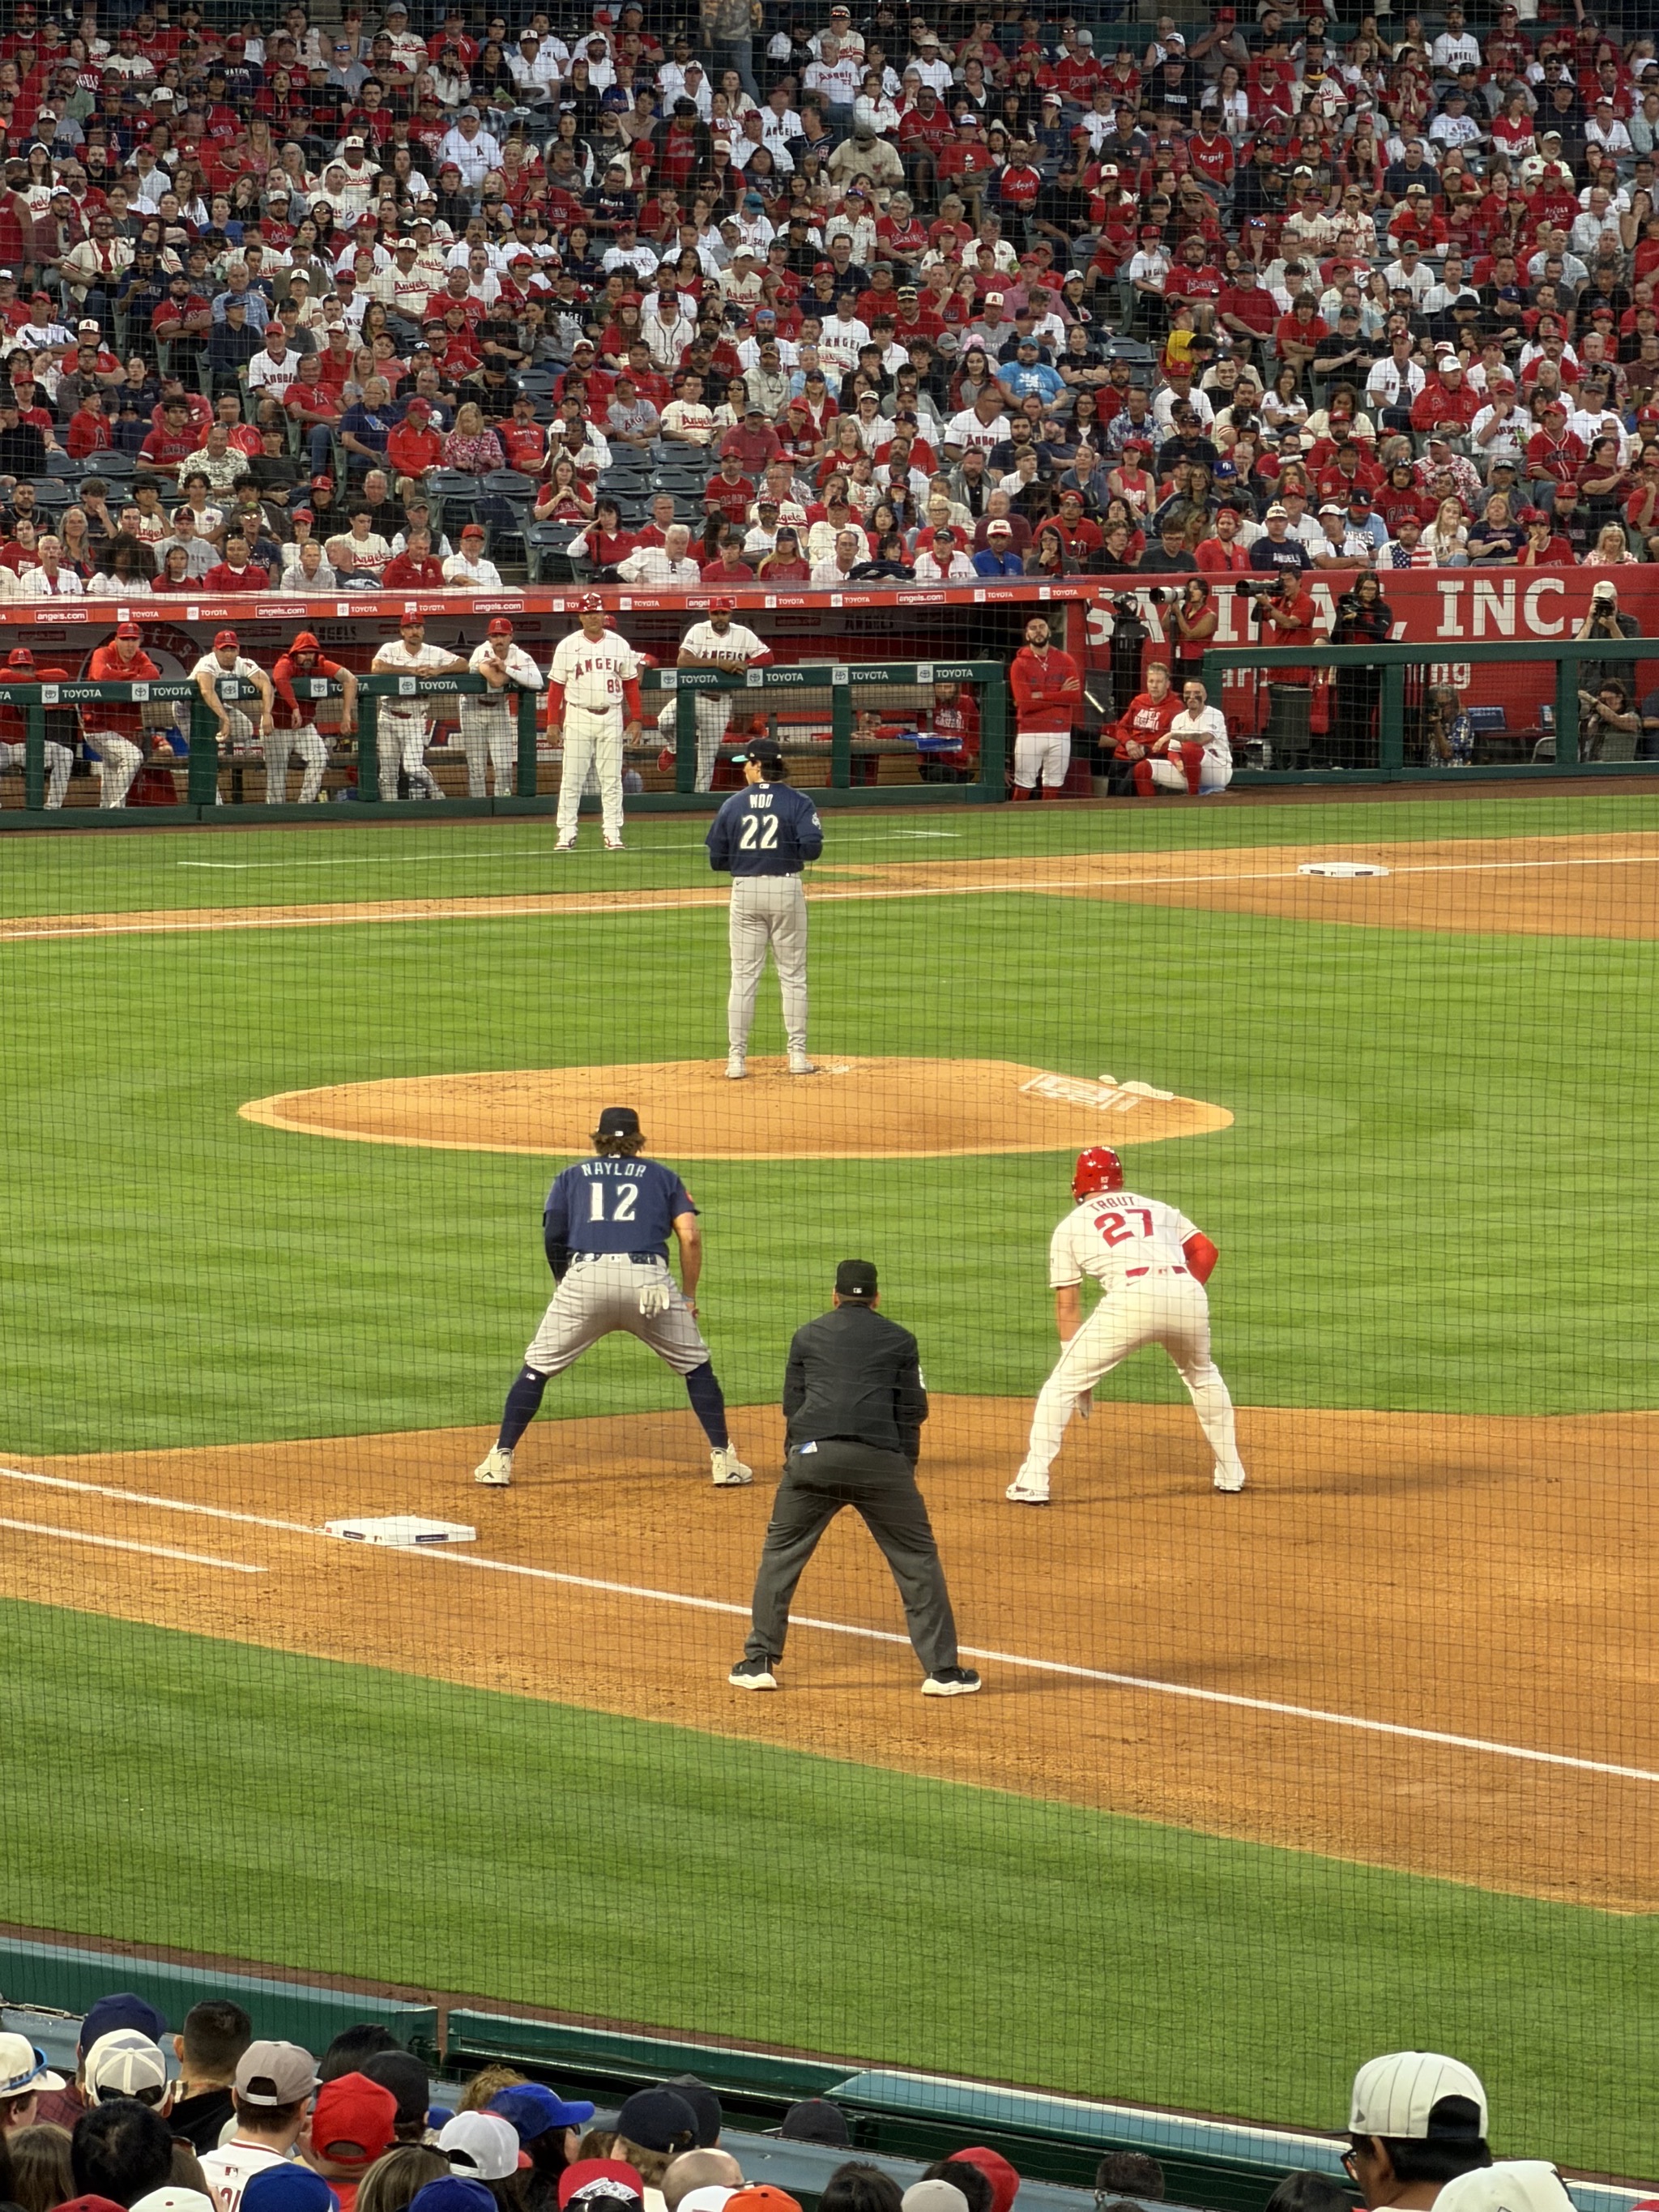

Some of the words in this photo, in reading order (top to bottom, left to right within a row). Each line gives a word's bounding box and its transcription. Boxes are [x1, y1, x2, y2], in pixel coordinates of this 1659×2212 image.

[394, 279, 429, 293] Angels
[825, 334, 860, 352] ANGEL
[899, 594, 943, 602] angels.com
[475, 603, 521, 611] angels.com
[1437, 578, 1584, 636] INC.
[37, 612, 85, 621] angels.com
[258, 608, 305, 617] angels.com
[766, 673, 804, 681] TOYOTA
[851, 671, 889, 680] TOYOTA
[936, 669, 973, 678] TOYOTA
[680, 675, 718, 684] TOYOTA
[419, 681, 458, 690] TOYOTA
[607, 679, 621, 694] 89
[62, 689, 101, 698] TOYOTA
[152, 687, 192, 696] TOYOTA
[749, 794, 774, 809] WOO
[740, 814, 778, 849] 22
[581, 1161, 646, 1177] NAYLOR
[587, 1182, 638, 1222] 12
[1086, 1196, 1137, 1212] TROUT
[1094, 1209, 1154, 1248] 27
